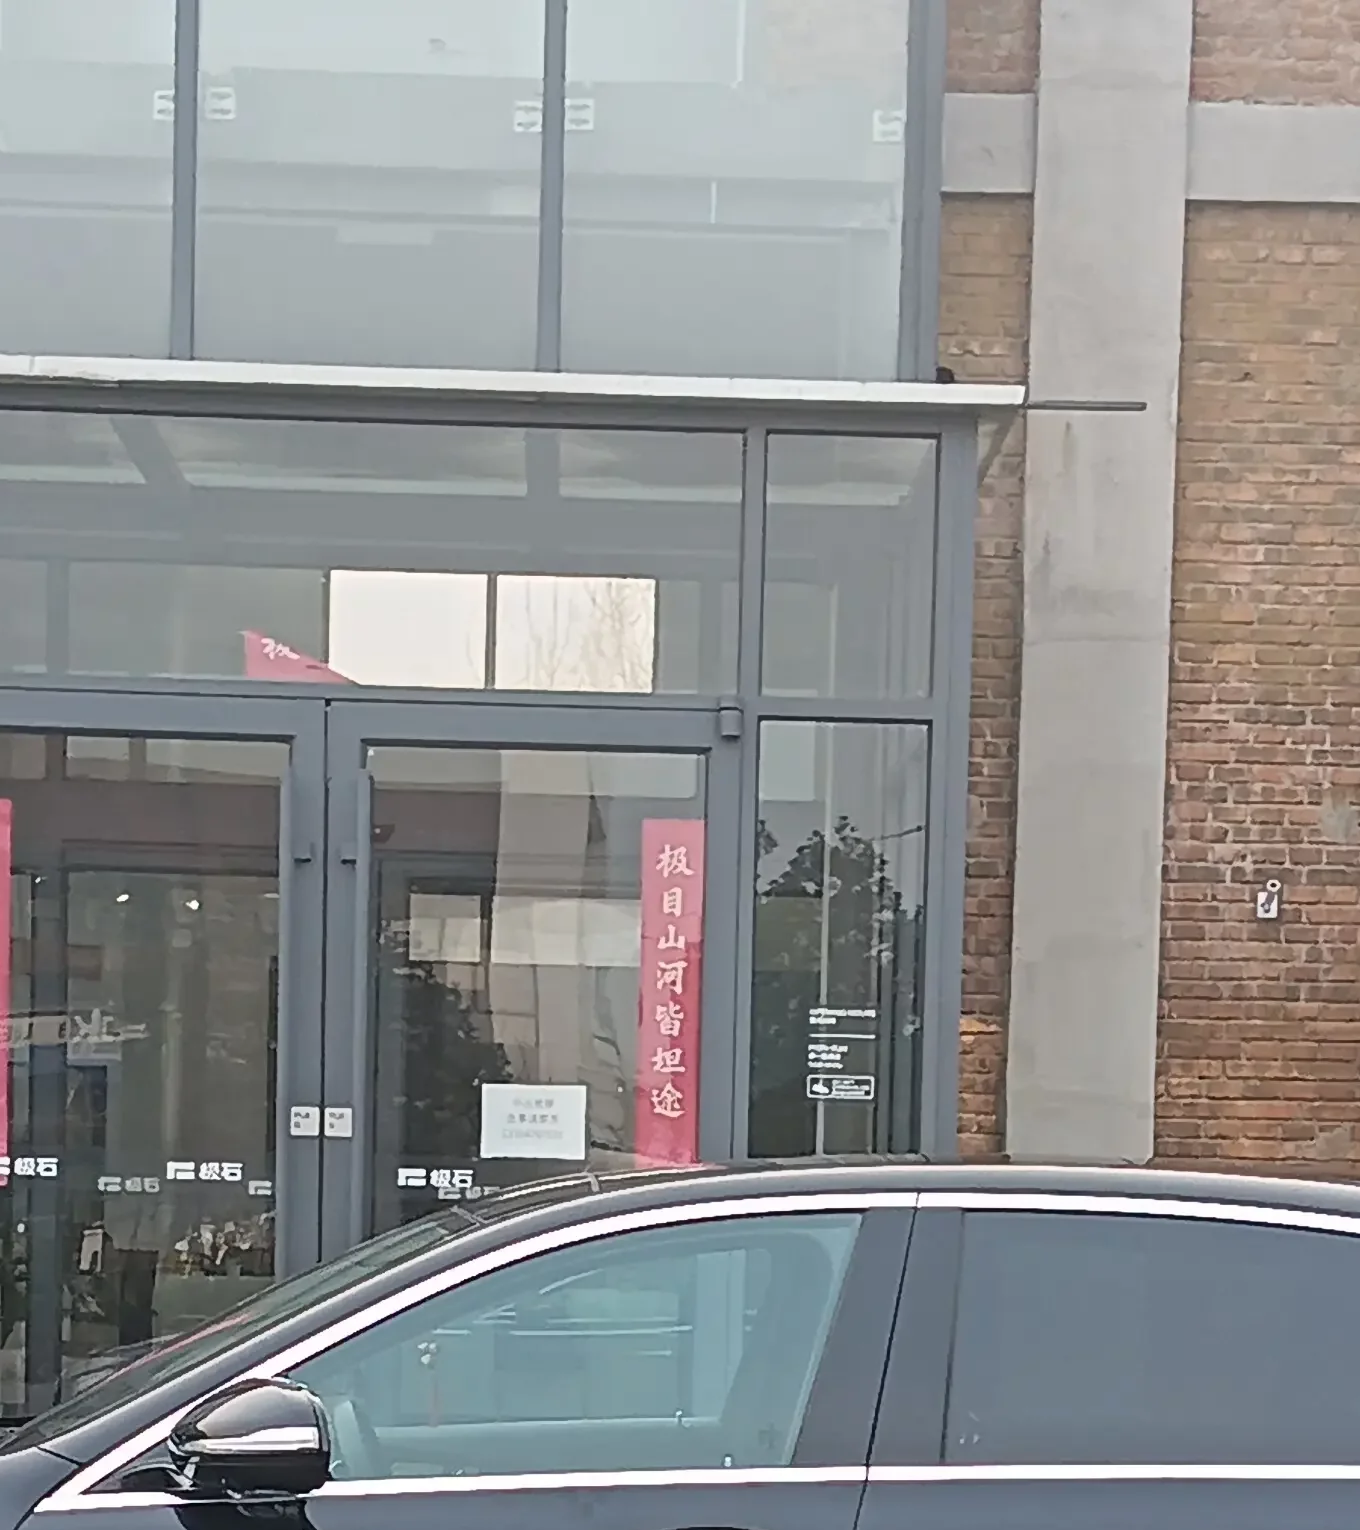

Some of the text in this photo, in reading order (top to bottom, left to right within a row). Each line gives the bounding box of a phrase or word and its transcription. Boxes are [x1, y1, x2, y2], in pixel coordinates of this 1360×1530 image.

[651, 843, 696, 1118] 极目山河皆坦途
[198, 1161, 244, 1182] 极石
